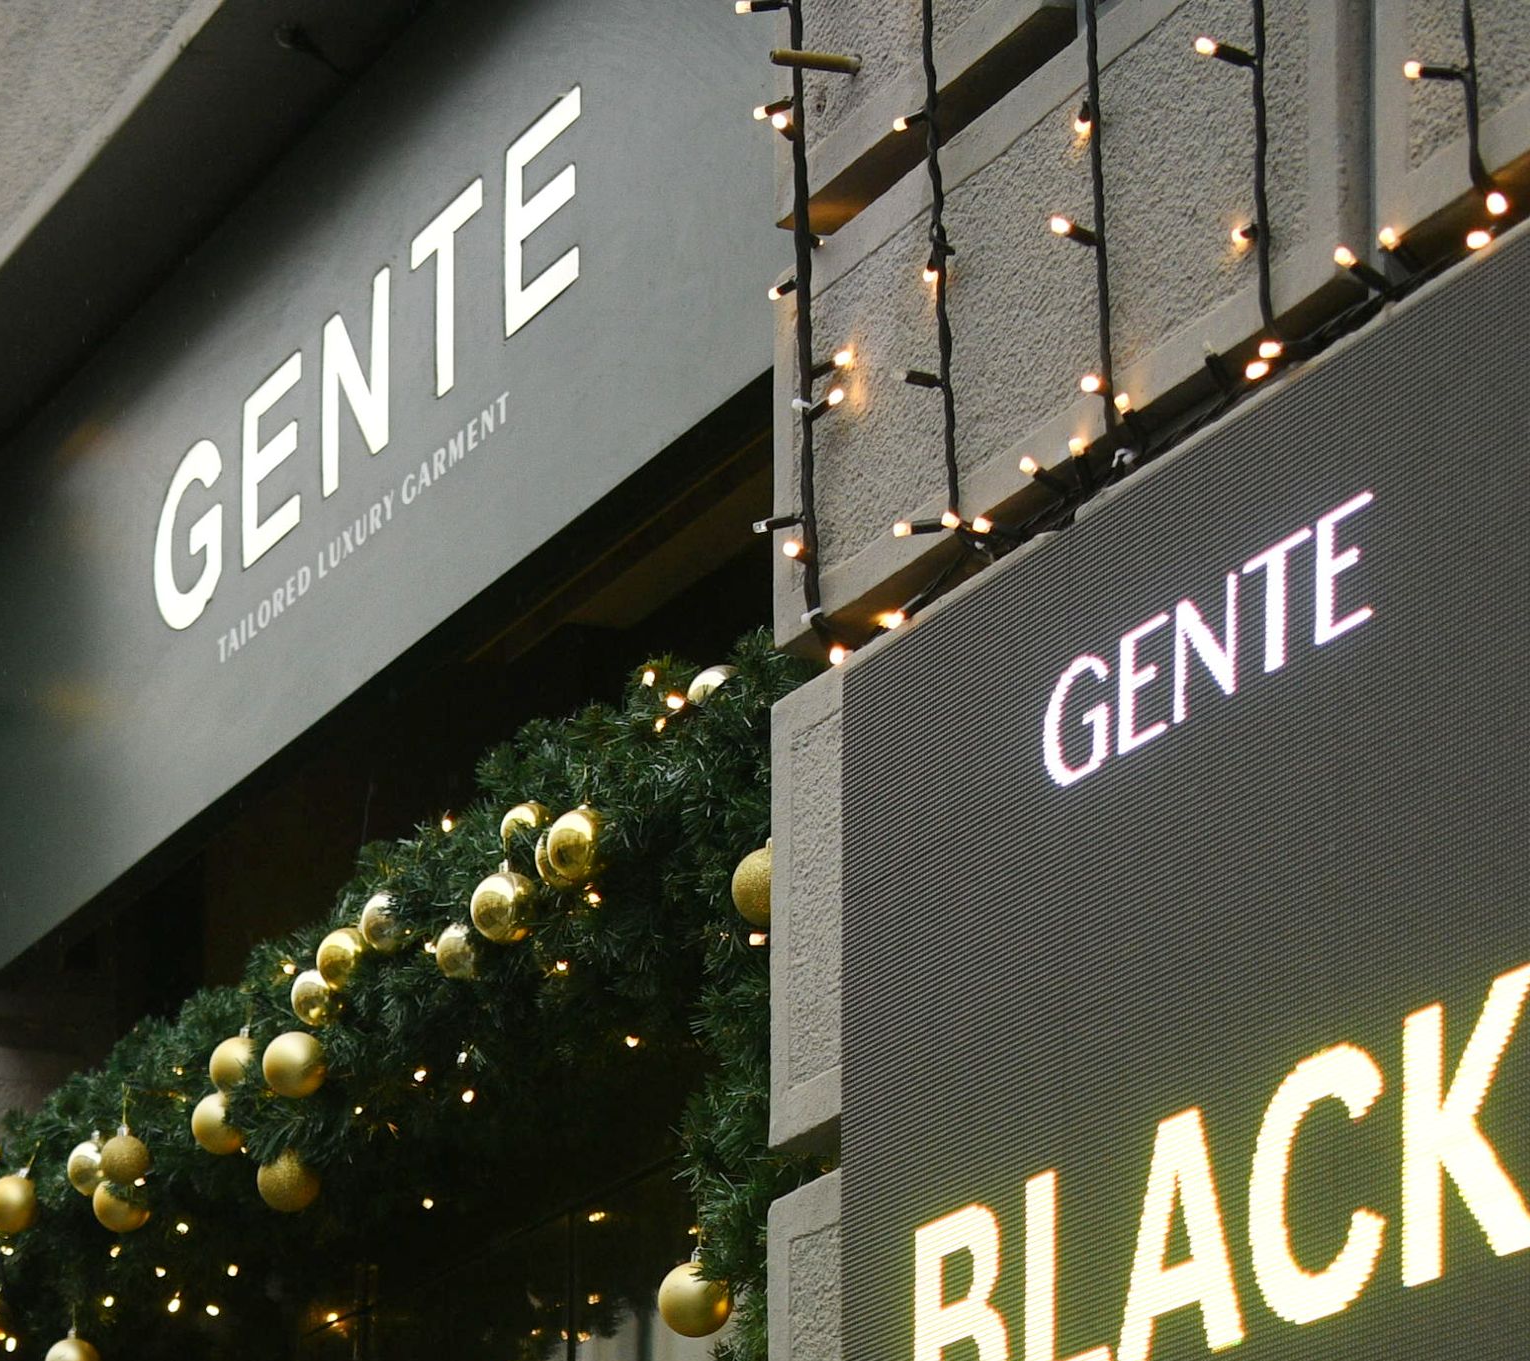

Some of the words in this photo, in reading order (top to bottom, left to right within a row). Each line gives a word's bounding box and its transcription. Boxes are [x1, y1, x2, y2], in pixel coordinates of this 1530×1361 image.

[153, 83, 582, 631] GENTE
[217, 573, 311, 663] TAILORED
[317, 496, 394, 579] LUXURY
[401, 391, 511, 506] GARMENT
[1042, 491, 1374, 788] GENTE
